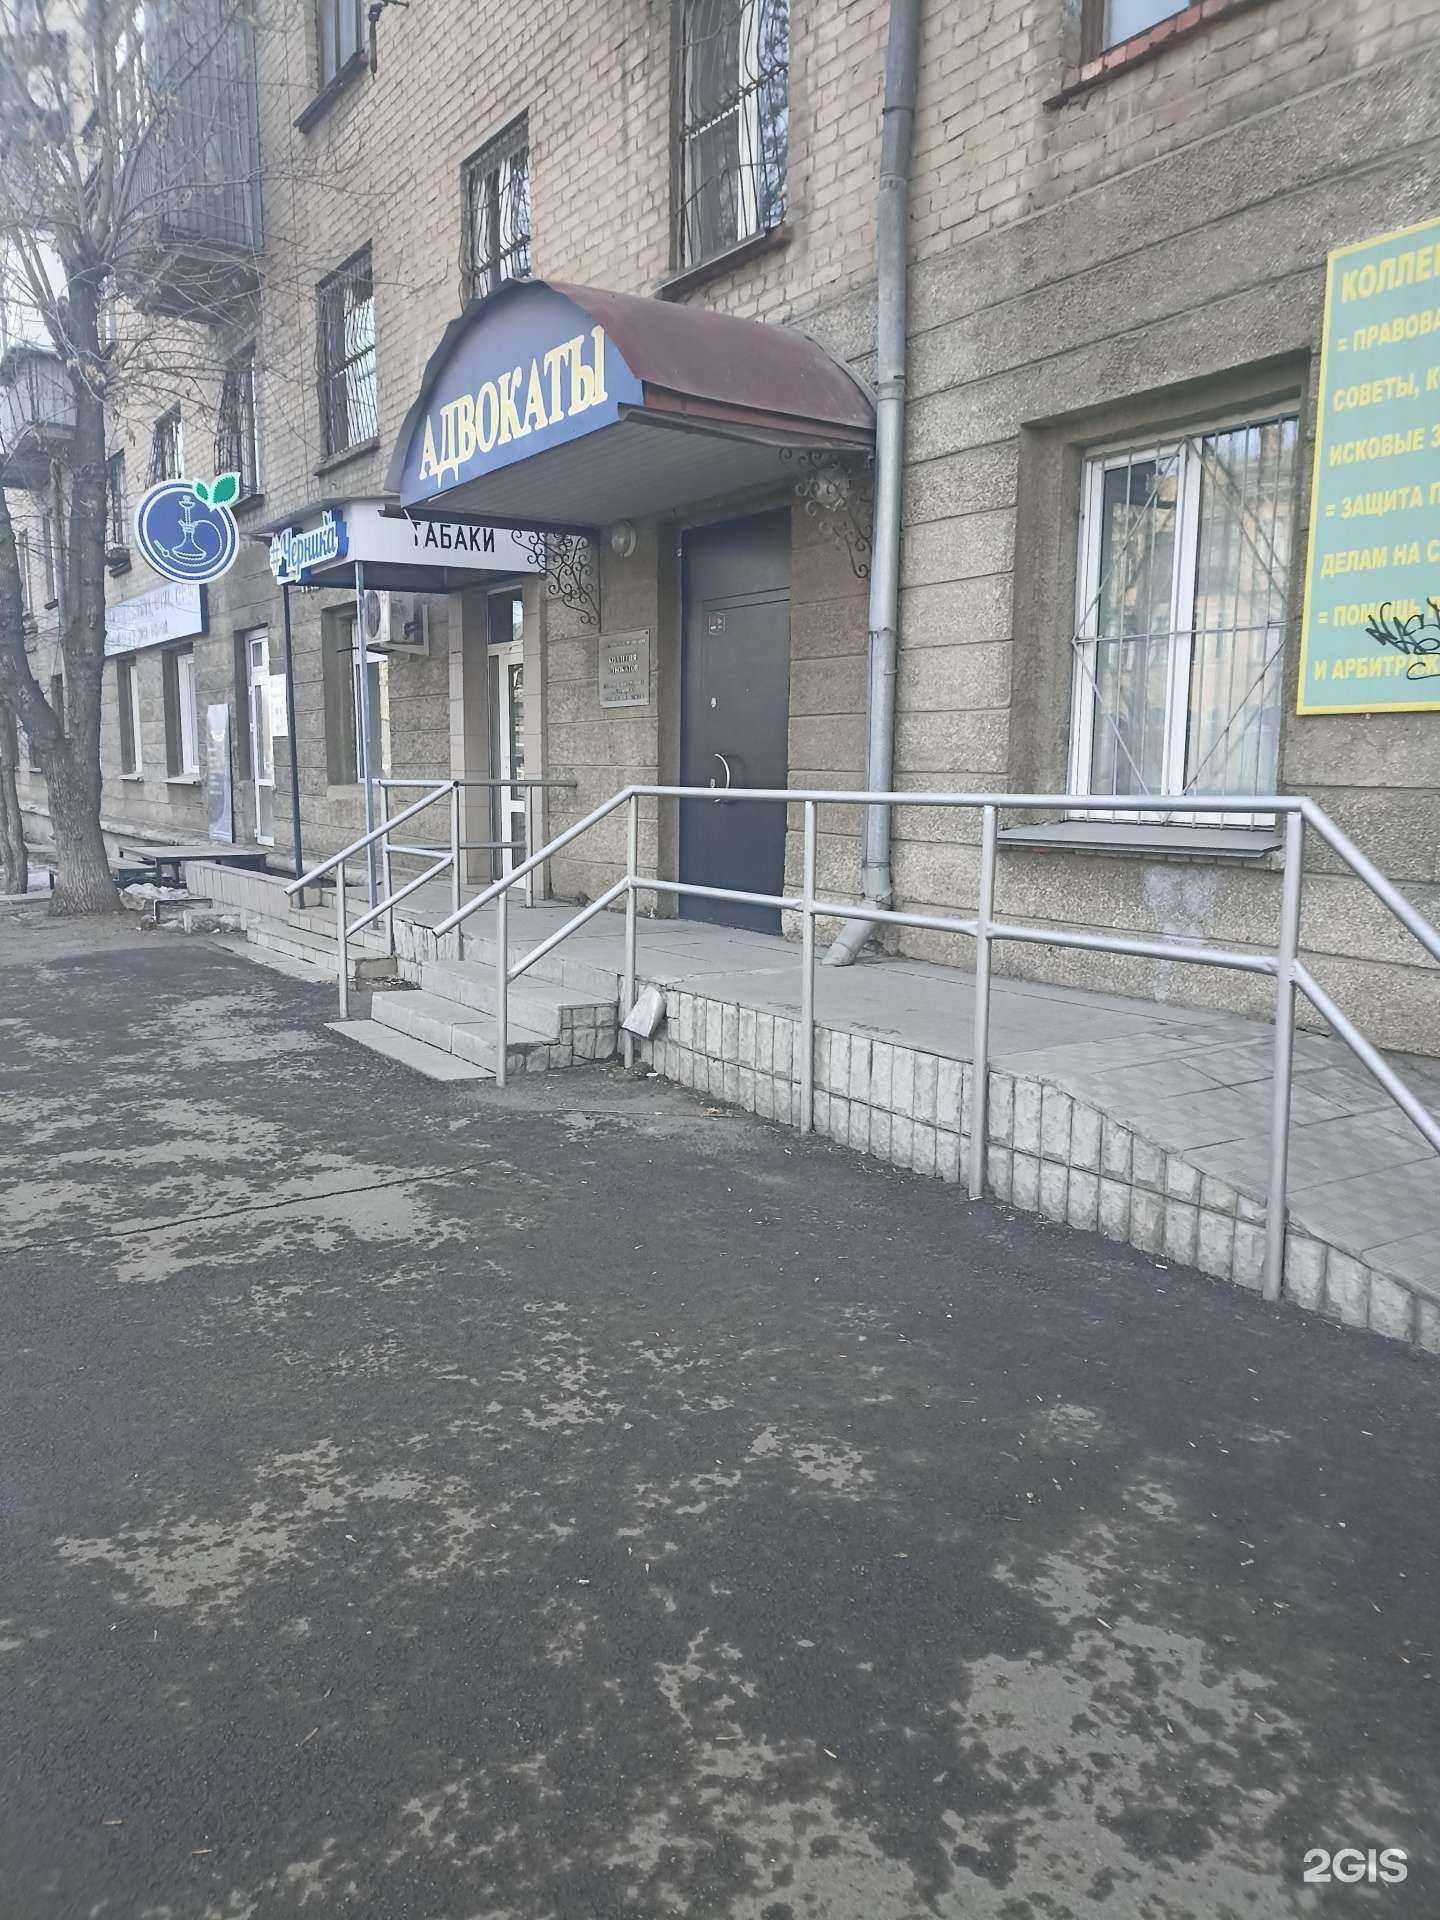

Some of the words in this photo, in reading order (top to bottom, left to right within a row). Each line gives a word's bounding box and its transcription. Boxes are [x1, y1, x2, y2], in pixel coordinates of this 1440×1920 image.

[419, 324, 608, 488] АДВОКАТЫ
[1333, 372, 1419, 412] СОВЕТЫ,
[1329, 427, 1425, 466] ИСКОВЫЕ
[1341, 485, 1423, 518] ЗАЩИТА
[1320, 545, 1388, 578] ДЕЛАМ
[1392, 542, 1421, 567] НА
[1314, 659, 1327, 680] И
